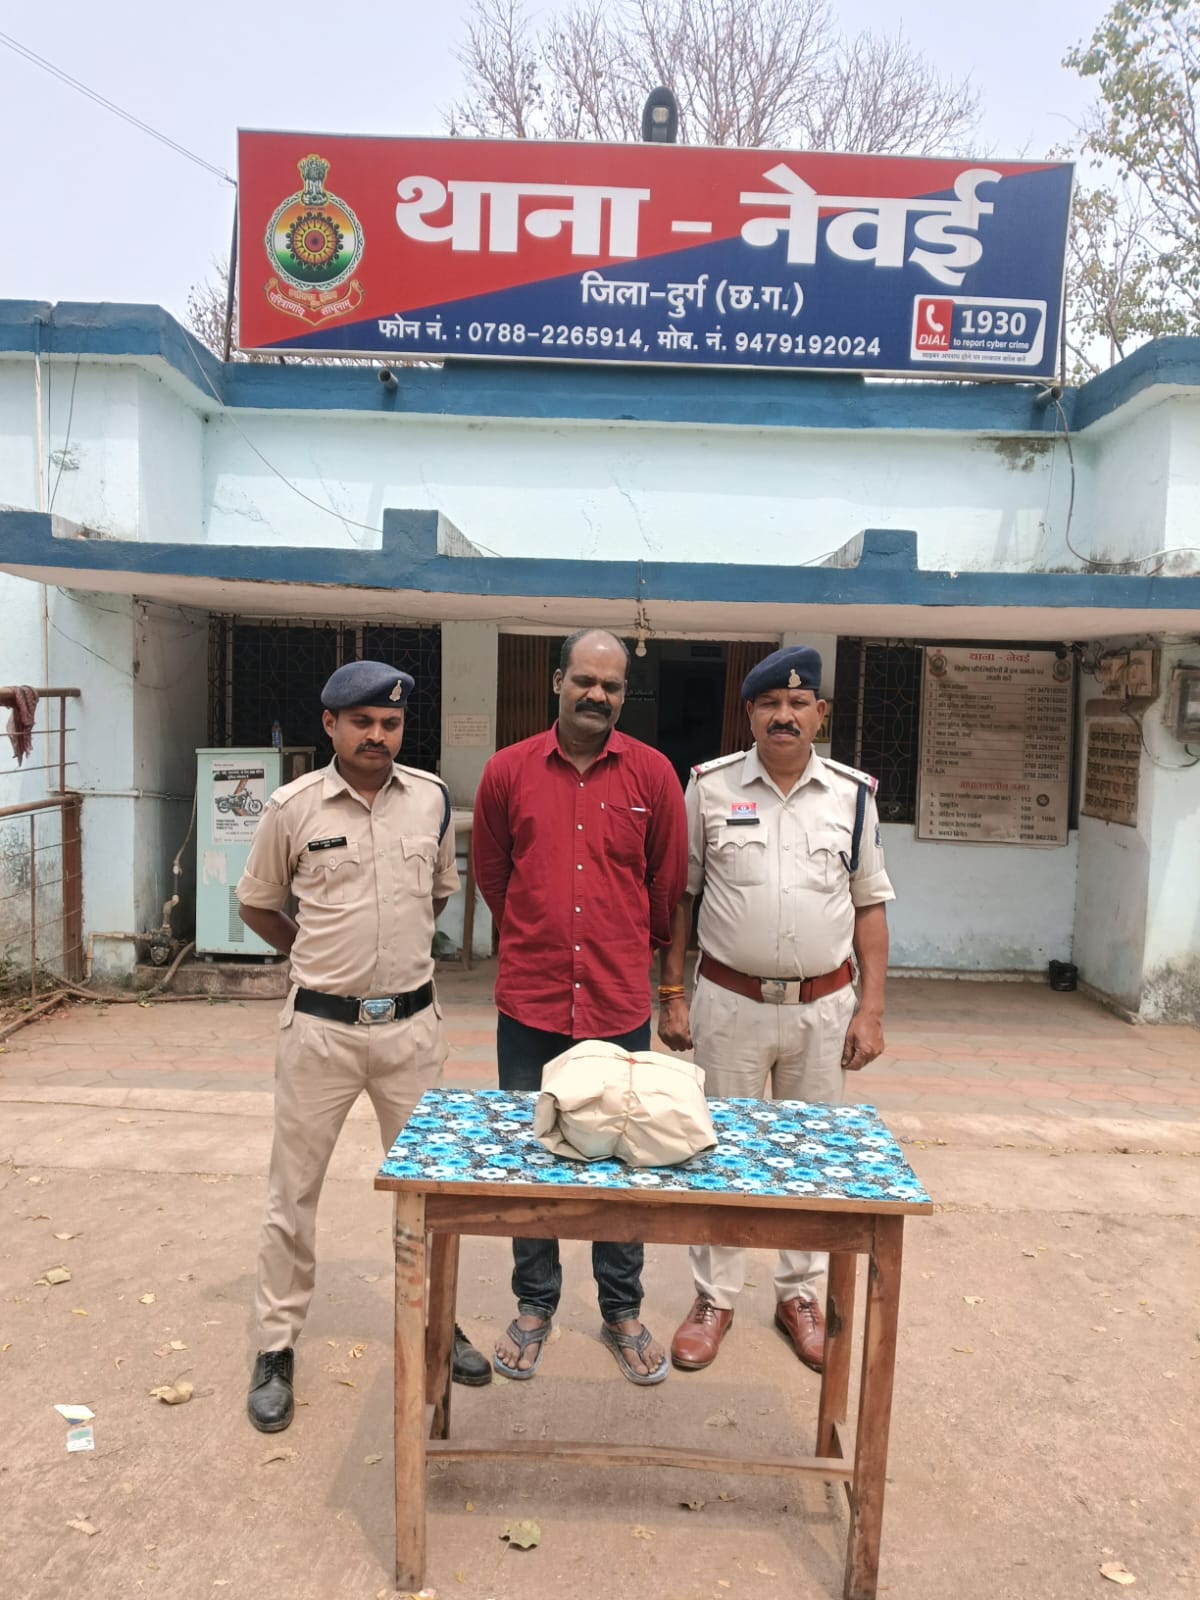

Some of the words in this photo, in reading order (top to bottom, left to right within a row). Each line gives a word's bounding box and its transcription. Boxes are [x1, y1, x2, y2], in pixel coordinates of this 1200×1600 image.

[395, 175, 651, 258] थाना
[671, 220, 712, 233] -
[739, 162, 1003, 287] नेवई
[580, 270, 709, 318] जिला-दुर्ग
[715, 279, 804, 317] (छ.ग.)
[377, 313, 421, 339] फोन
[425, 314, 447, 341] नं.
[468, 322, 650, 352] 0788-2265914,
[657, 323, 699, 350] मोब.
[705, 325, 727, 351] नं.
[735, 331, 881, 356] 9479192024
[961, 310, 1026, 335] 1930
[919, 334, 948, 346] DIAL
[953, 337, 960, 346] to
[962, 339, 985, 349] report
[986, 339, 1007, 350] cyber
[1008, 339, 1030, 350] crime
